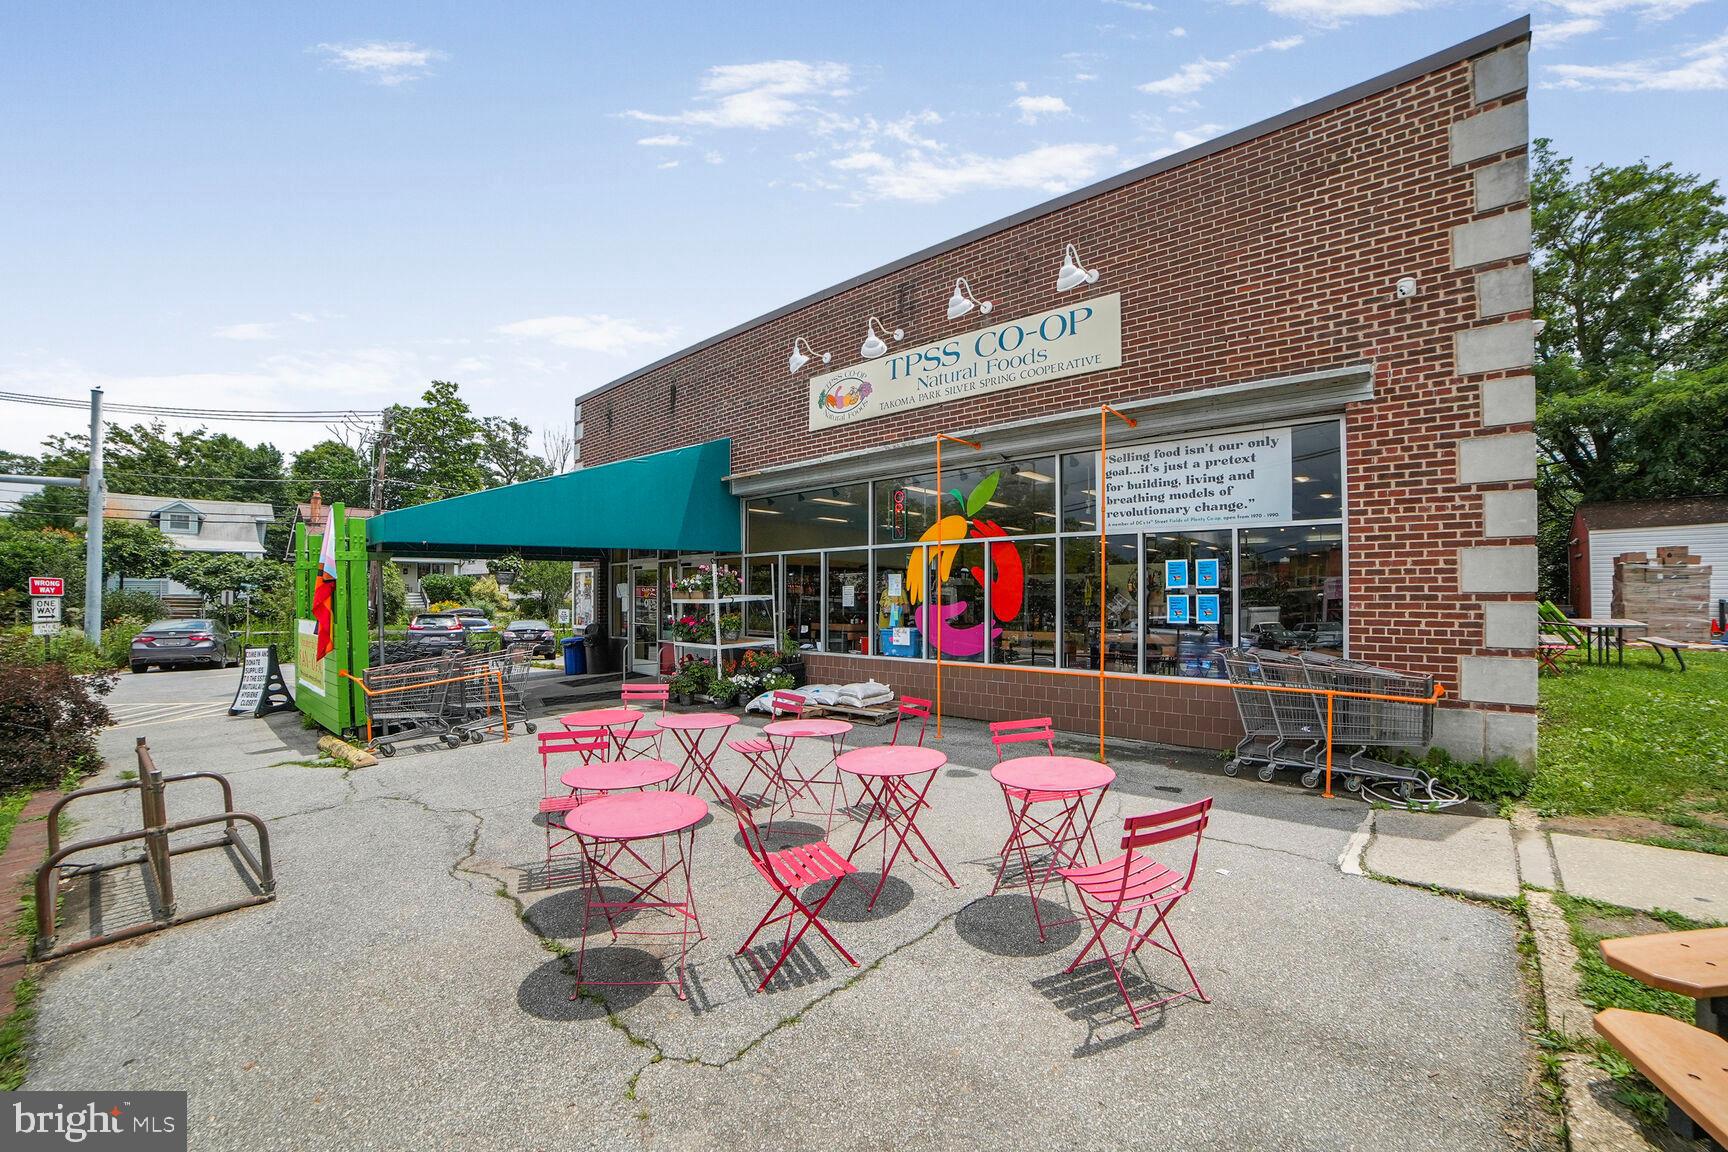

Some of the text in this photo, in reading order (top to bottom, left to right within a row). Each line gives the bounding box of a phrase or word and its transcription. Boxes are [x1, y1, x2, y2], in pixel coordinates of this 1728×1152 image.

[886, 307, 1093, 380] TPSS CO-OP
[916, 348, 1048, 391] Natural Foods
[879, 353, 1103, 412] TAKOMA PARK SILVER SPRING COOPERATIVE
[1154, 446, 1181, 459] food
[1185, 443, 1214, 455] isn't
[1218, 442, 1244, 452] our
[1247, 435, 1280, 448] only
[1105, 463, 1160, 479] goal...it's
[1163, 460, 1188, 474] just
[1205, 452, 1257, 470] pretext
[1106, 469, 1255, 492] for building, living and
[1106, 485, 1234, 506] breathing models of
[1106, 505, 1191, 519] revolutionary
